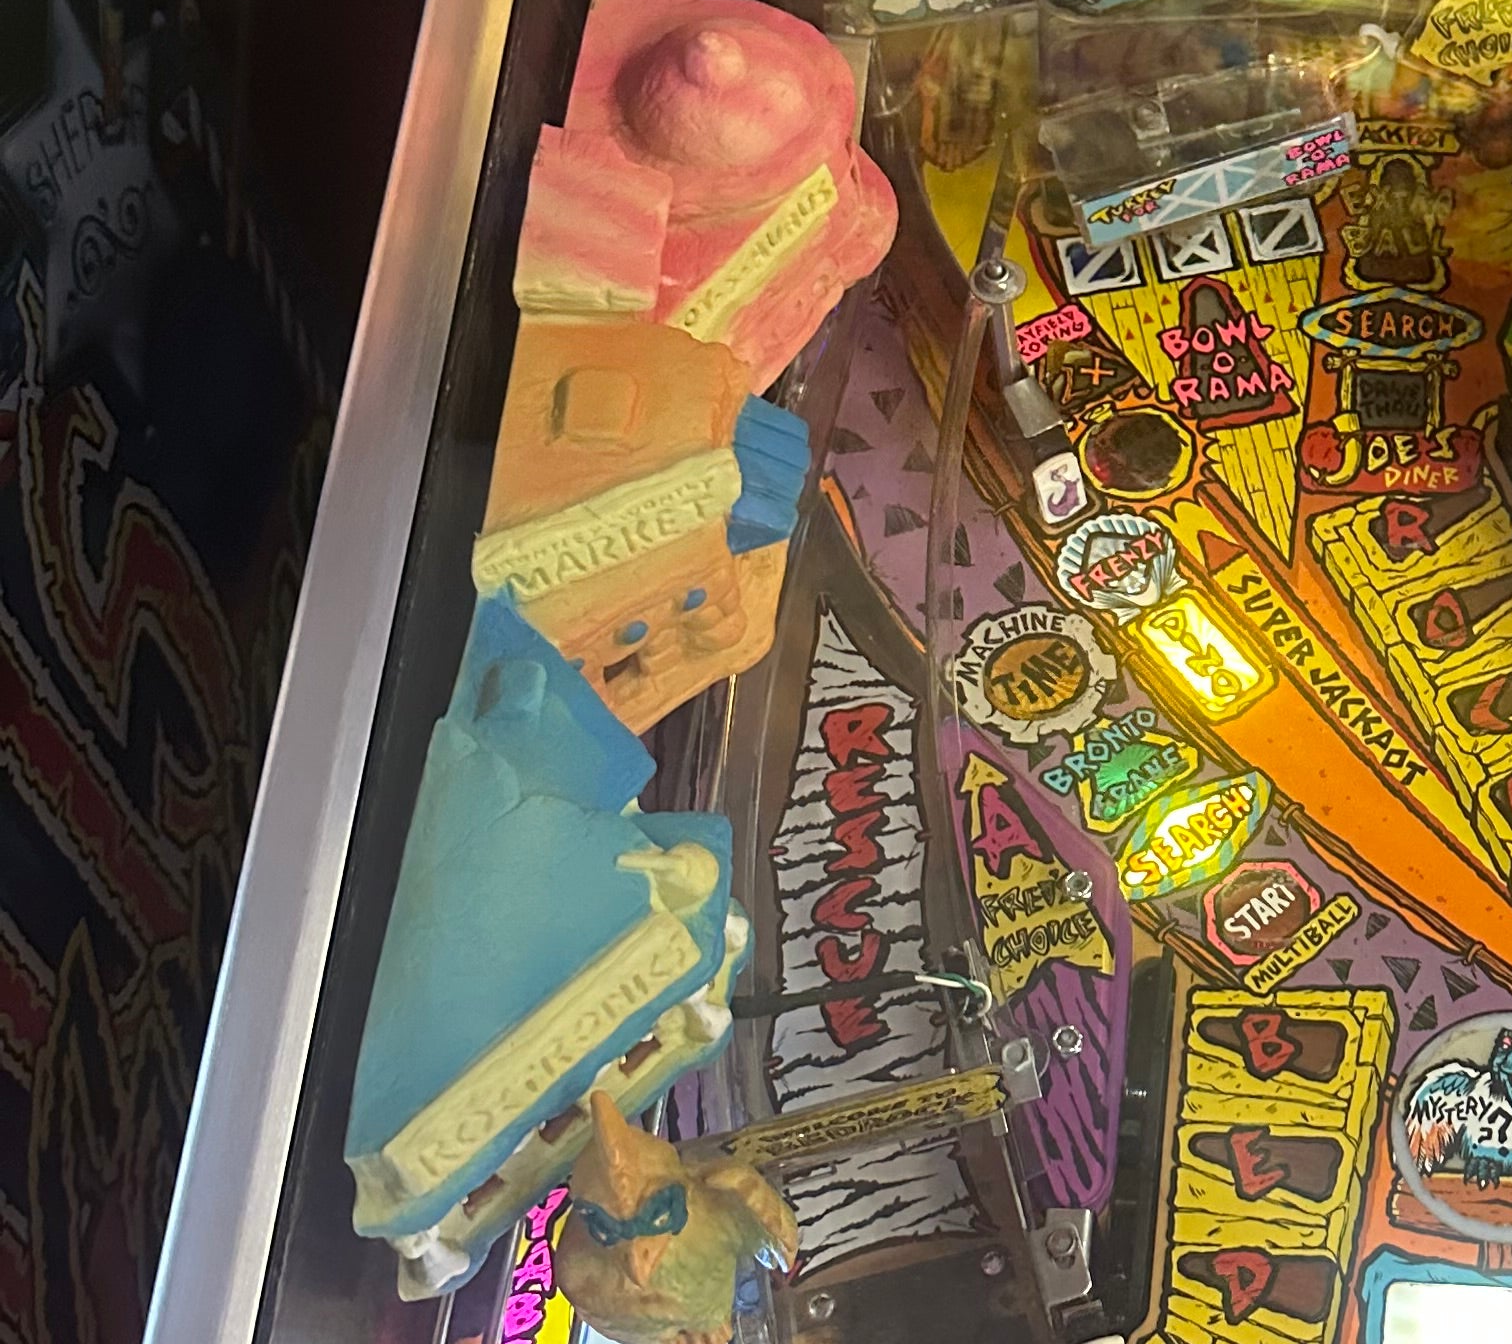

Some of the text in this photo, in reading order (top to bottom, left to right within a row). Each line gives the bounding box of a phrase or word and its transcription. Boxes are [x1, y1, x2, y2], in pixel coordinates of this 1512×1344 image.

[1285, 129, 1345, 162] BOWL
[1356, 123, 1453, 150] ACKPOT
[1283, 153, 1351, 186] RAMA
[1087, 178, 1177, 225] TURKEY
[1016, 308, 1076, 344] AYFIELD
[1019, 319, 1085, 358] CORING
[1160, 312, 1276, 360] BOWL
[1334, 309, 1456, 341] SEARCH
[1170, 363, 1296, 408] RAMA
[1383, 465, 1461, 491] DINER
[506, 492, 712, 592] MARKET
[1068, 531, 1165, 603] FRENZY
[957, 614, 1067, 688] MACHINE
[991, 640, 1079, 706] TIME
[1149, 608, 1243, 697] DINO
[1227, 573, 1429, 787] SUPER JACKPOT
[1040, 708, 1158, 796] BRONTO
[1126, 782, 1255, 887] SEARCH
[1223, 880, 1297, 940] START
[991, 908, 1098, 969] CHOICE
[1251, 900, 1356, 992] MULTIBALL
[1409, 1094, 1492, 1127] MYSTERY
